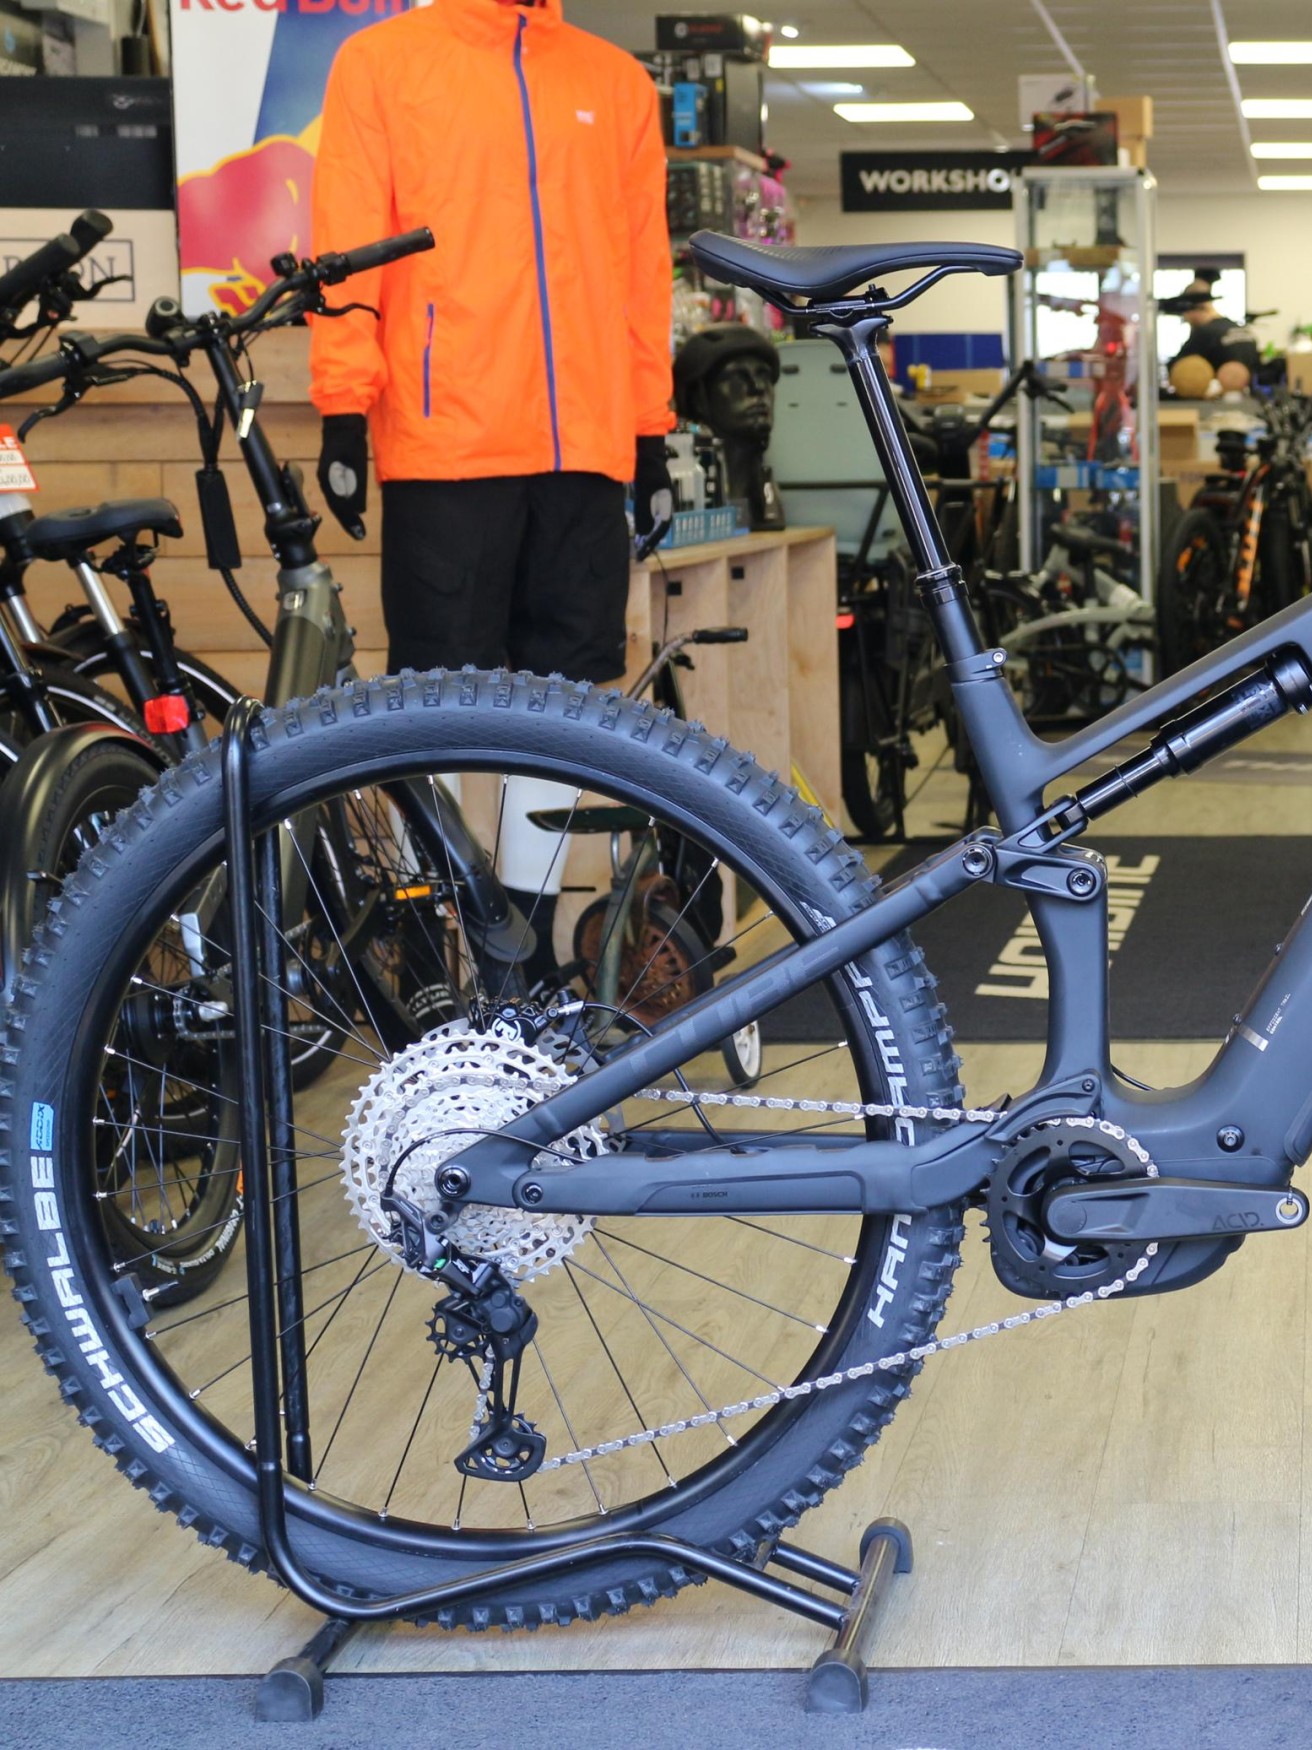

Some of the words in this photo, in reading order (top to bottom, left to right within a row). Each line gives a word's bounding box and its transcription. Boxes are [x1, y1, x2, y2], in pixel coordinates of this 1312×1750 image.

[858, 168, 1013, 194] WORKSHO
[30, 1156, 176, 1453] SCHWALBE
[868, 1214, 912, 1328] HAN
